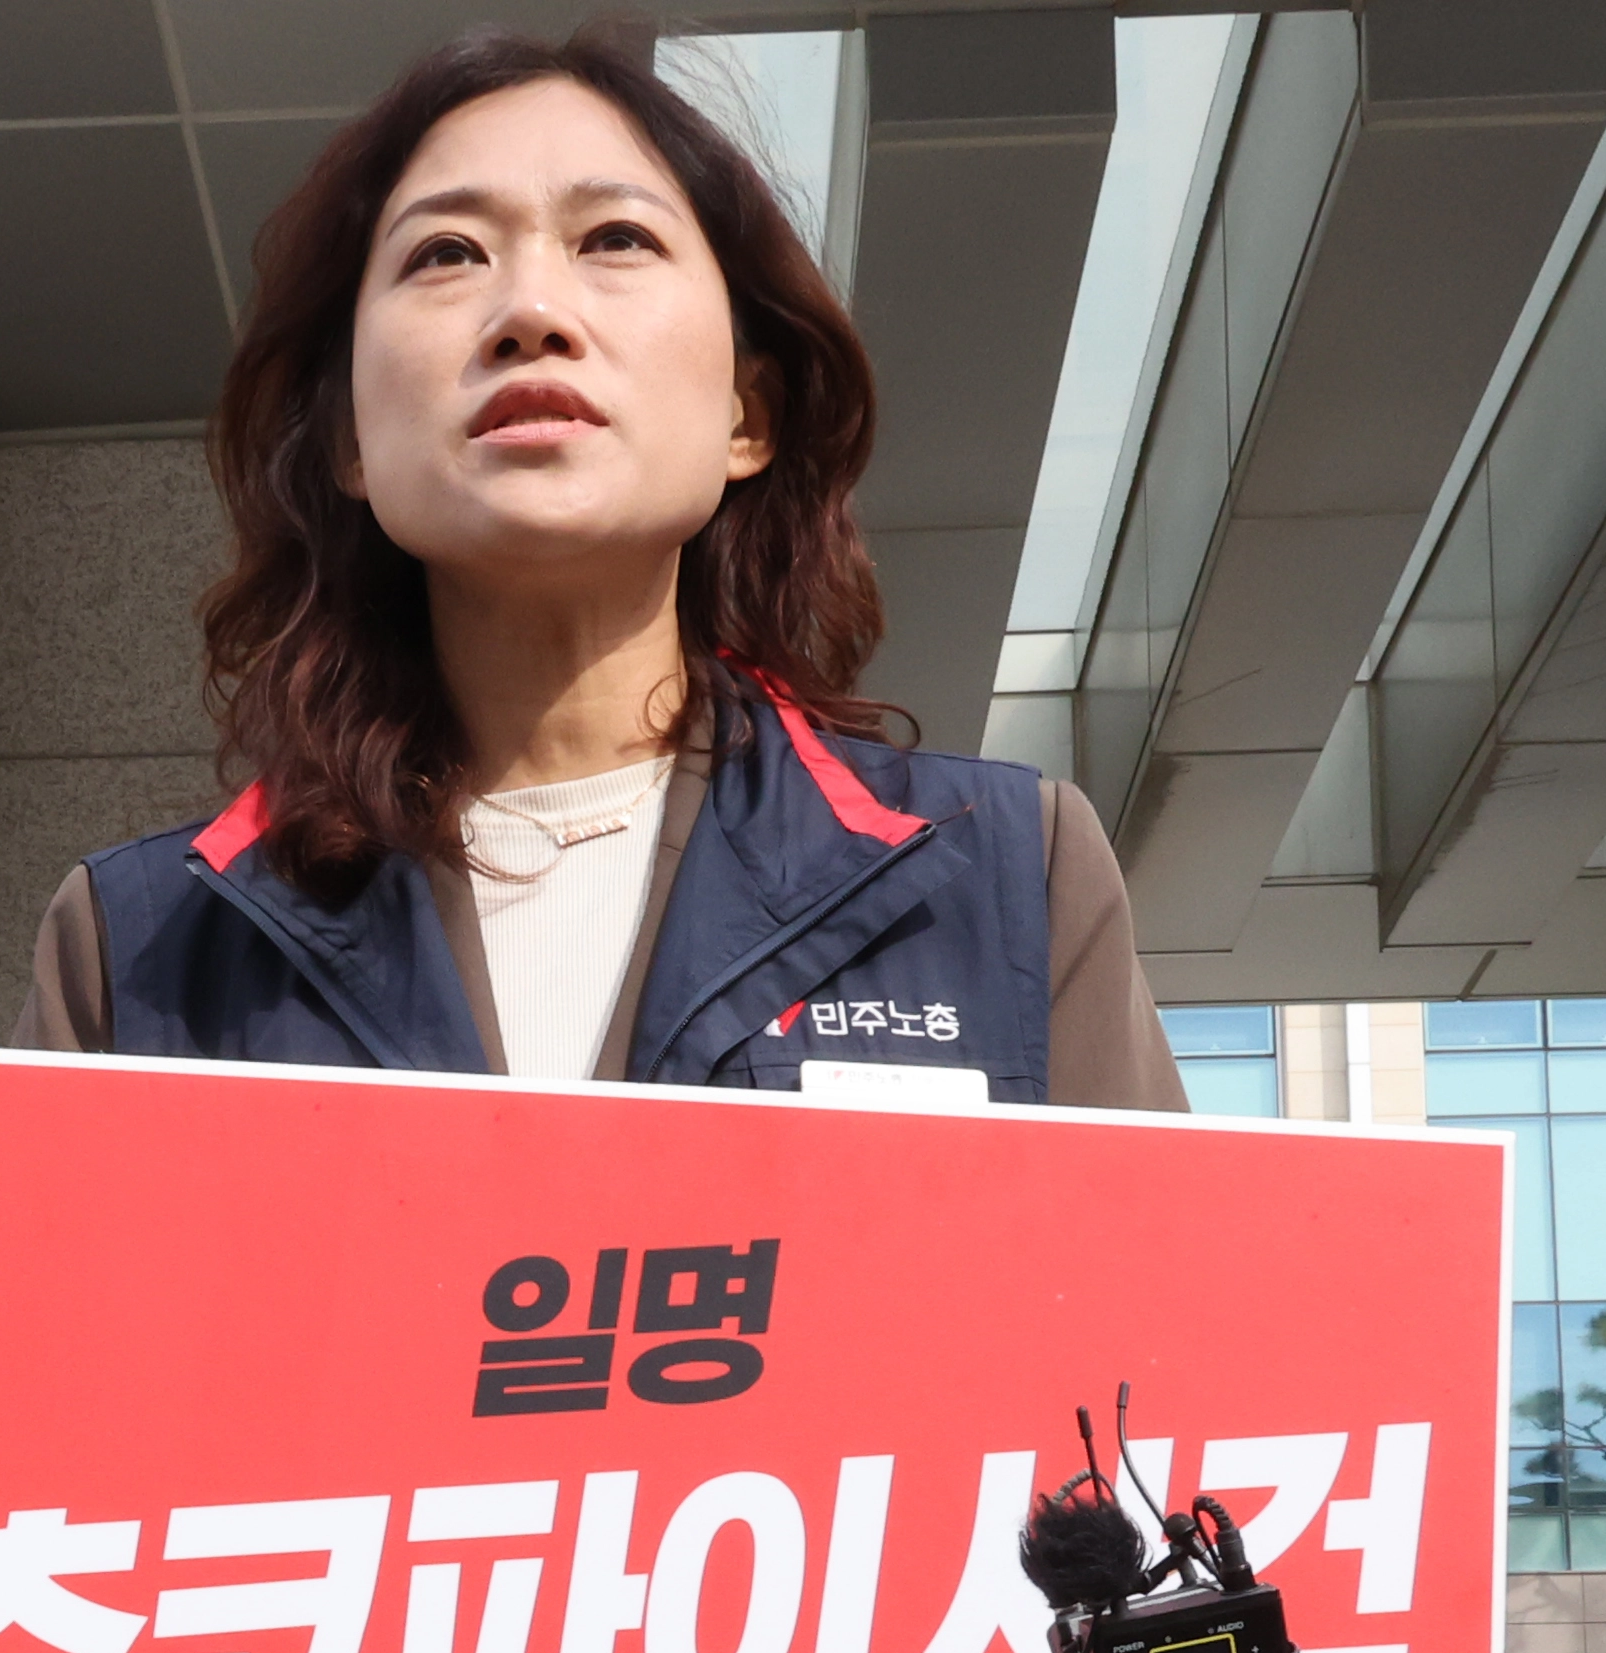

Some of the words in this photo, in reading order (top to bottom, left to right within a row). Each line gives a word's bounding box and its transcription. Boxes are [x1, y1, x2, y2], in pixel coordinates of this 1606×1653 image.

[810, 999, 960, 1042] 민주노총
[470, 1237, 781, 1418] 일명
[1113, 1641, 1145, 1653] POWER
[1217, 1621, 1244, 1633] AUDIO
